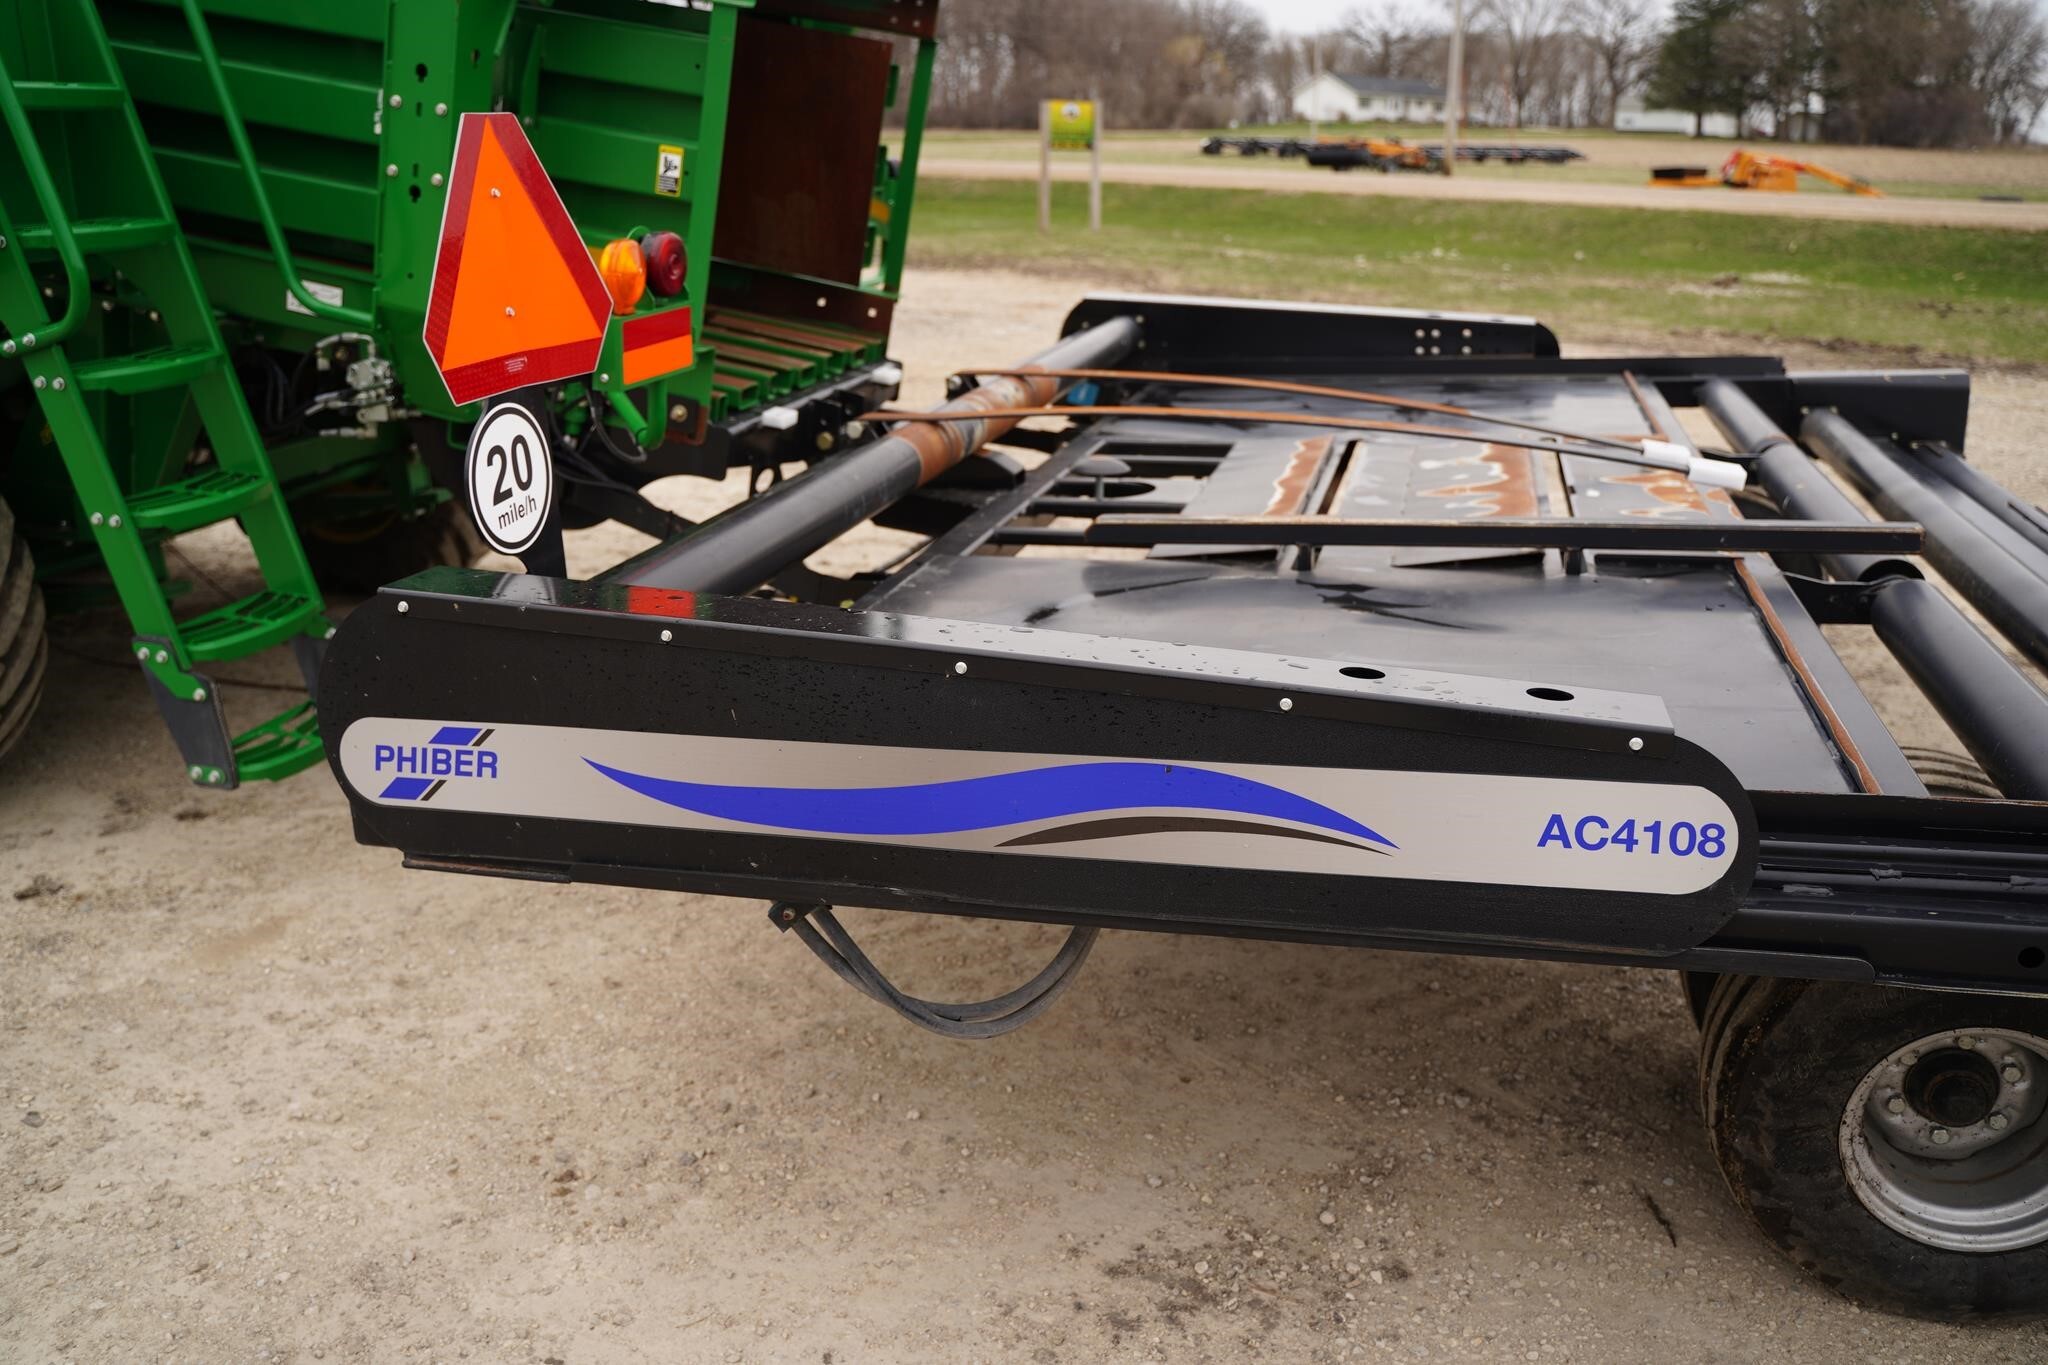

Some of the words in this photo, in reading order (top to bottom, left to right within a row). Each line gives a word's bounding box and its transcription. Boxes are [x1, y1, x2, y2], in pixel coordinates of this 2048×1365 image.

[487, 434, 533, 507] 20
[498, 495, 537, 530] mile/h
[375, 745, 498, 779] PHIBER
[1537, 814, 1726, 858] AC4108
